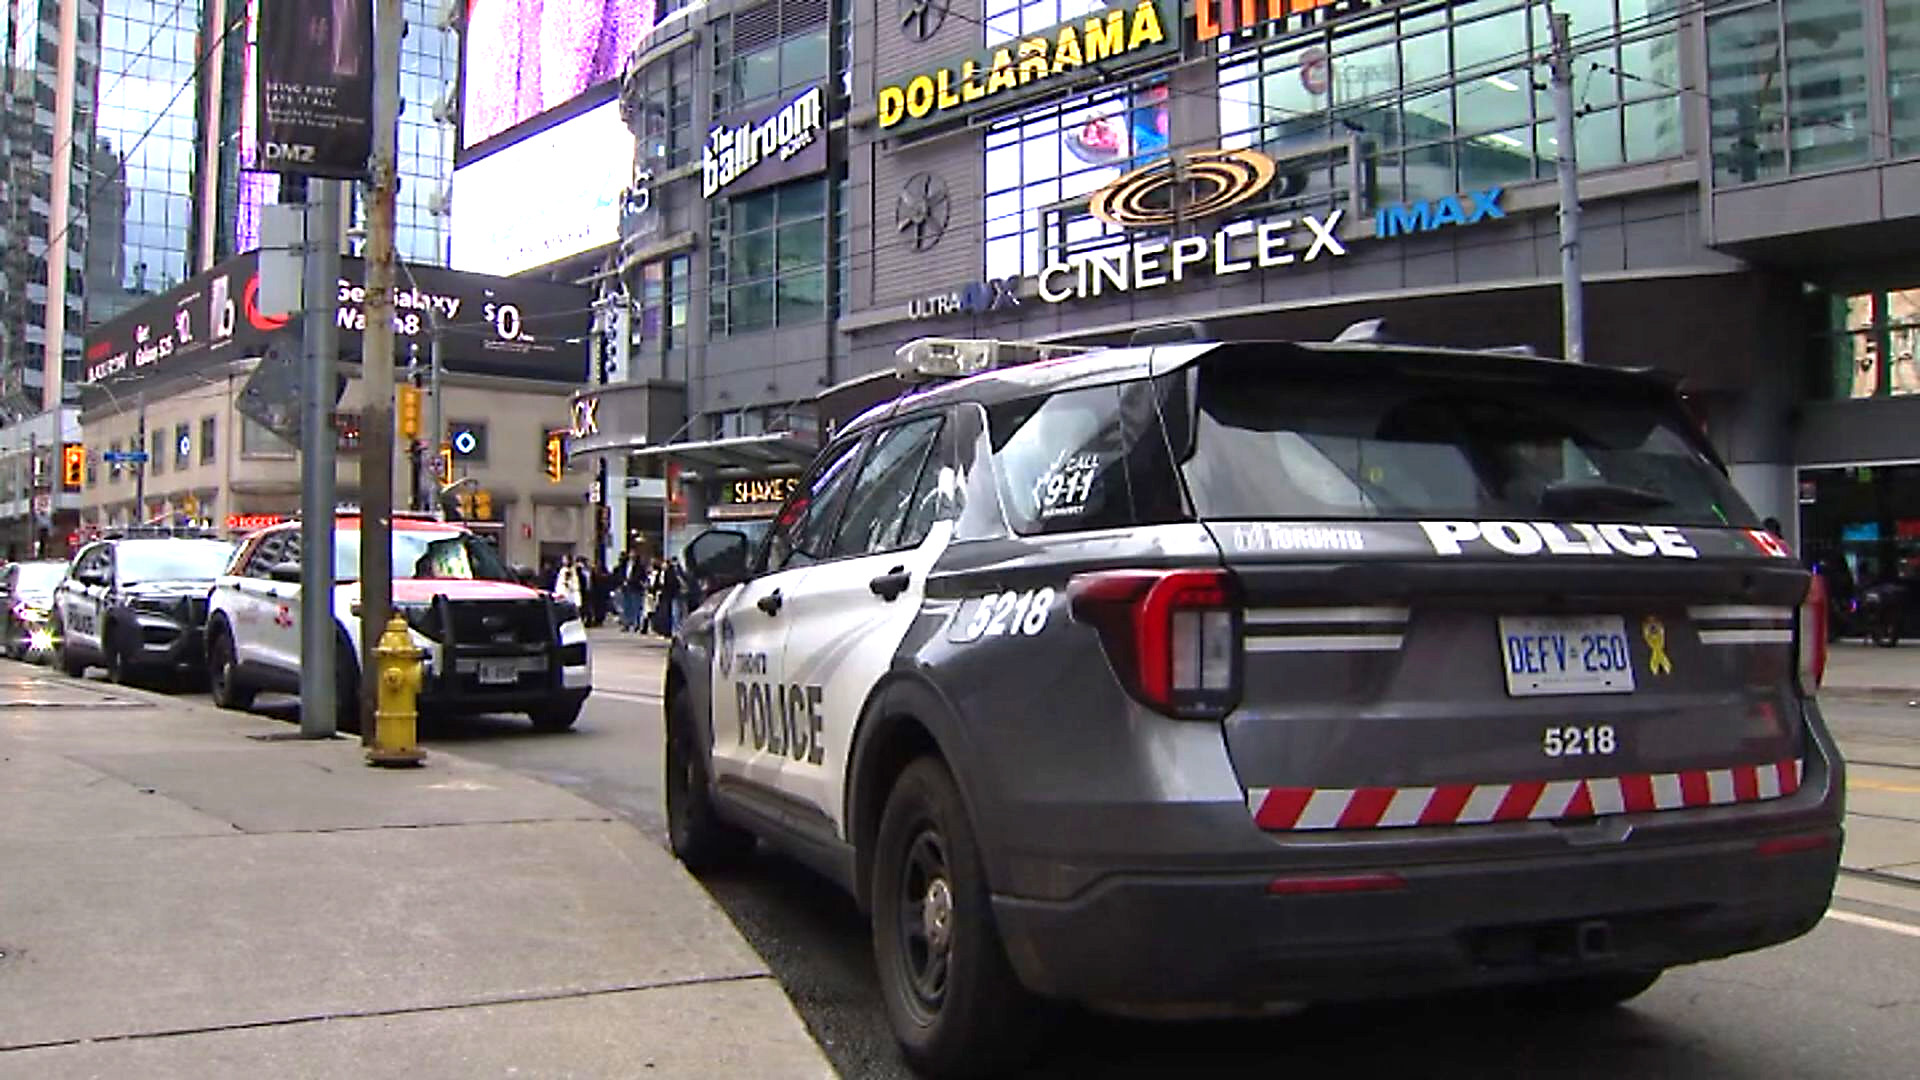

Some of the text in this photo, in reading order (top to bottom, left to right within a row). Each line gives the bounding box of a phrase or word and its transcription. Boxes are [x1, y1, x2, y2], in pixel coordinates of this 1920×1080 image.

[879, 0, 1164, 128] DOLLARAMA
[266, 142, 316, 163] DMZ
[1374, 187, 1506, 239] IMAX
[1037, 208, 1346, 303] CINEPLEX
[393, 286, 460, 319] alaxy
[735, 479, 784, 503] SHAKE
[1263, 523, 1364, 550] TORONTO
[1418, 520, 1698, 559] POLICE
[967, 586, 1055, 639] 5218
[735, 681, 825, 766] POLICE
[1544, 724, 1616, 757] 5218
